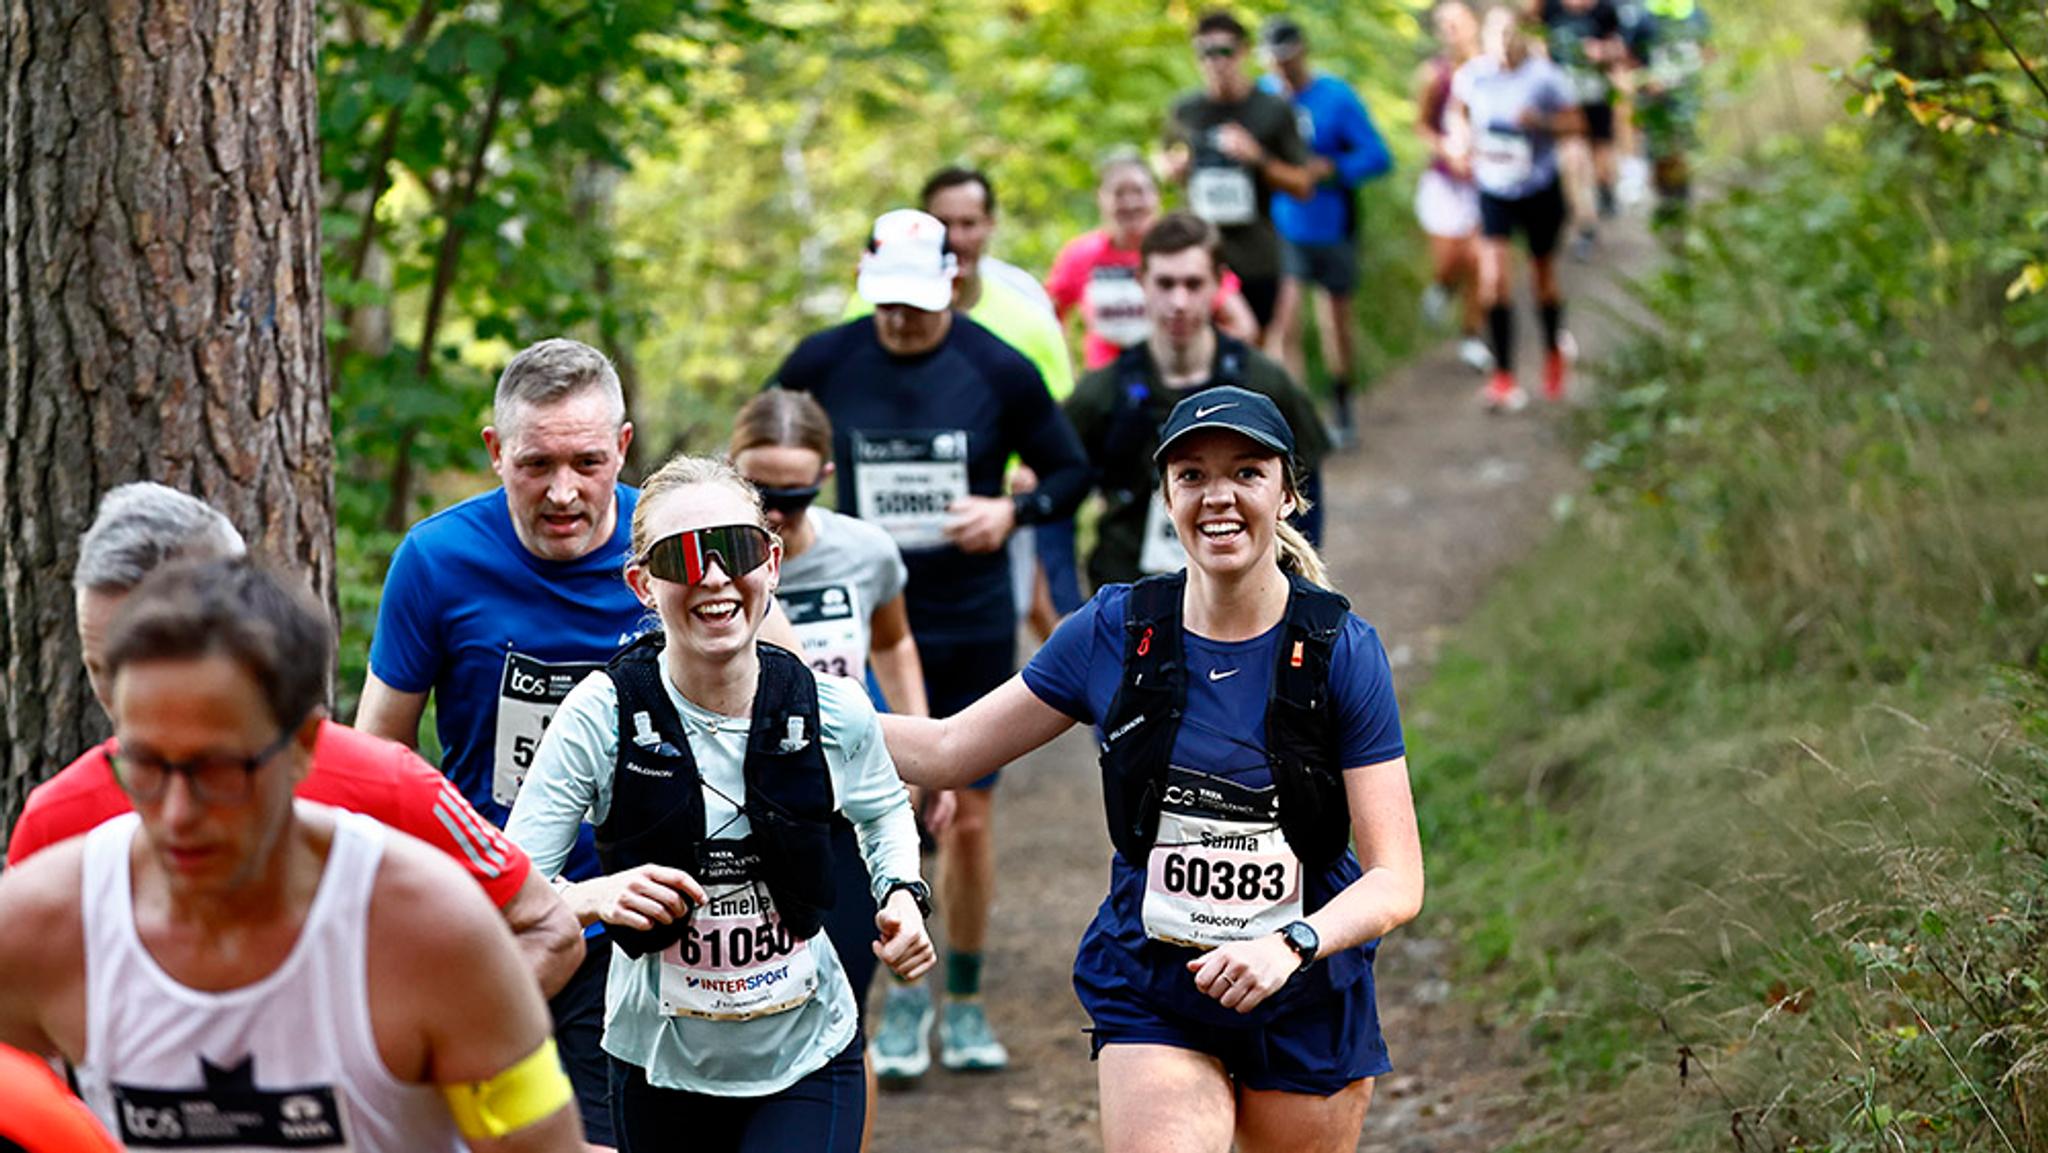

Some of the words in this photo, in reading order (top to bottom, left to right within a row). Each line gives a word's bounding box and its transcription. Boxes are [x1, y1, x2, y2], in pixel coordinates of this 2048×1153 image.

[511, 666, 546, 696] tcs
[708, 851, 735, 859] TATA
[1200, 830, 1259, 852] Sanna
[1164, 853, 1285, 902] 60383
[710, 895, 771, 917] Emele
[1189, 911, 1249, 930] saucony
[680, 923, 795, 969] 61050
[700, 965, 790, 995] INTERSPORT
[121, 1100, 183, 1140] tcs
